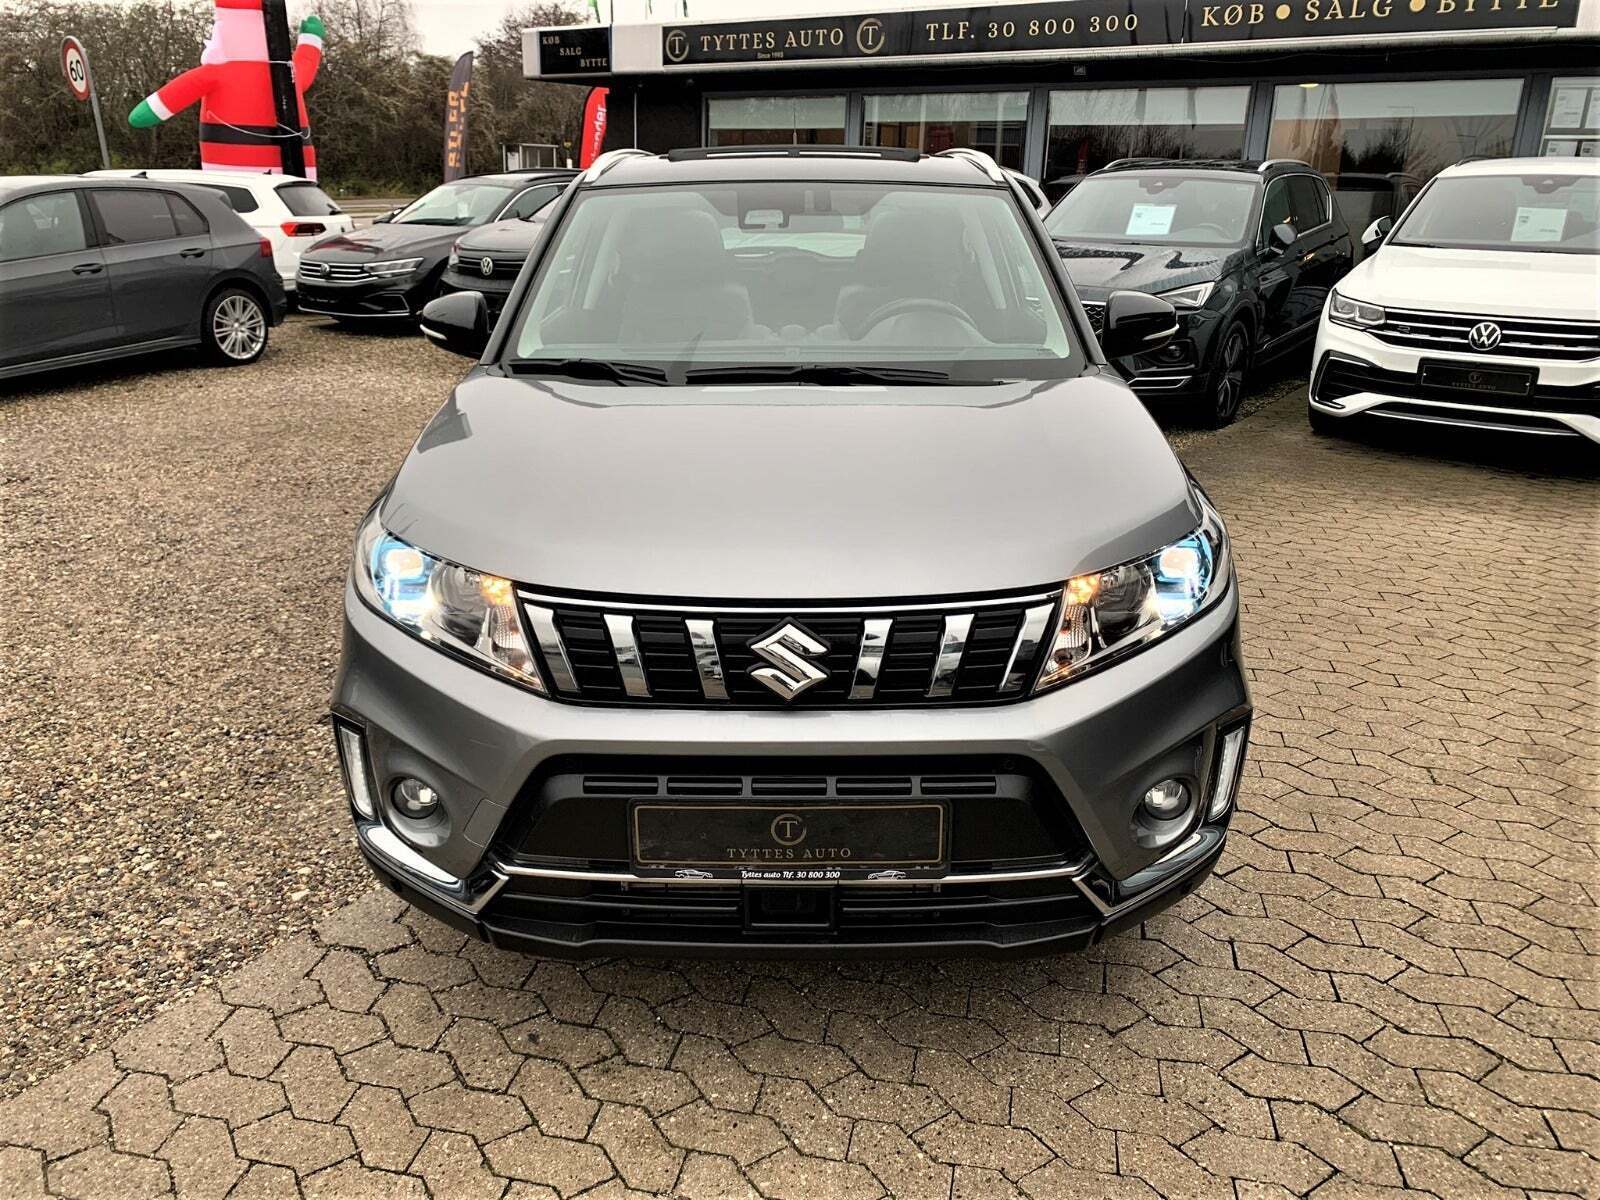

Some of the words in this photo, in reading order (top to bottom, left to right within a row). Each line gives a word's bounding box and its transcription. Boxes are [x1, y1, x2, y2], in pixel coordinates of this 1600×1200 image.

[1201, 3, 1265, 27] KØB
[1304, 0, 1393, 21] SALG
[926, 21, 975, 41] TLF.
[988, 21, 1015, 38] 30
[1028, 17, 1075, 36] 800
[1089, 13, 1138, 33] 300
[542, 36, 560, 45] KØB
[700, 31, 775, 51] TYTTES
[785, 28, 844, 48] AUTO
[560, 47, 582, 56] SALG
[580, 58, 608, 67] BYTTE
[69, 59, 84, 82] 60
[726, 848, 794, 859] TYTTES
[803, 847, 851, 858] AUTO
[740, 870, 762, 879] Tyttes
[796, 870, 806, 878] 30
[807, 870, 824, 878] 800
[824, 870, 841, 878] 300
